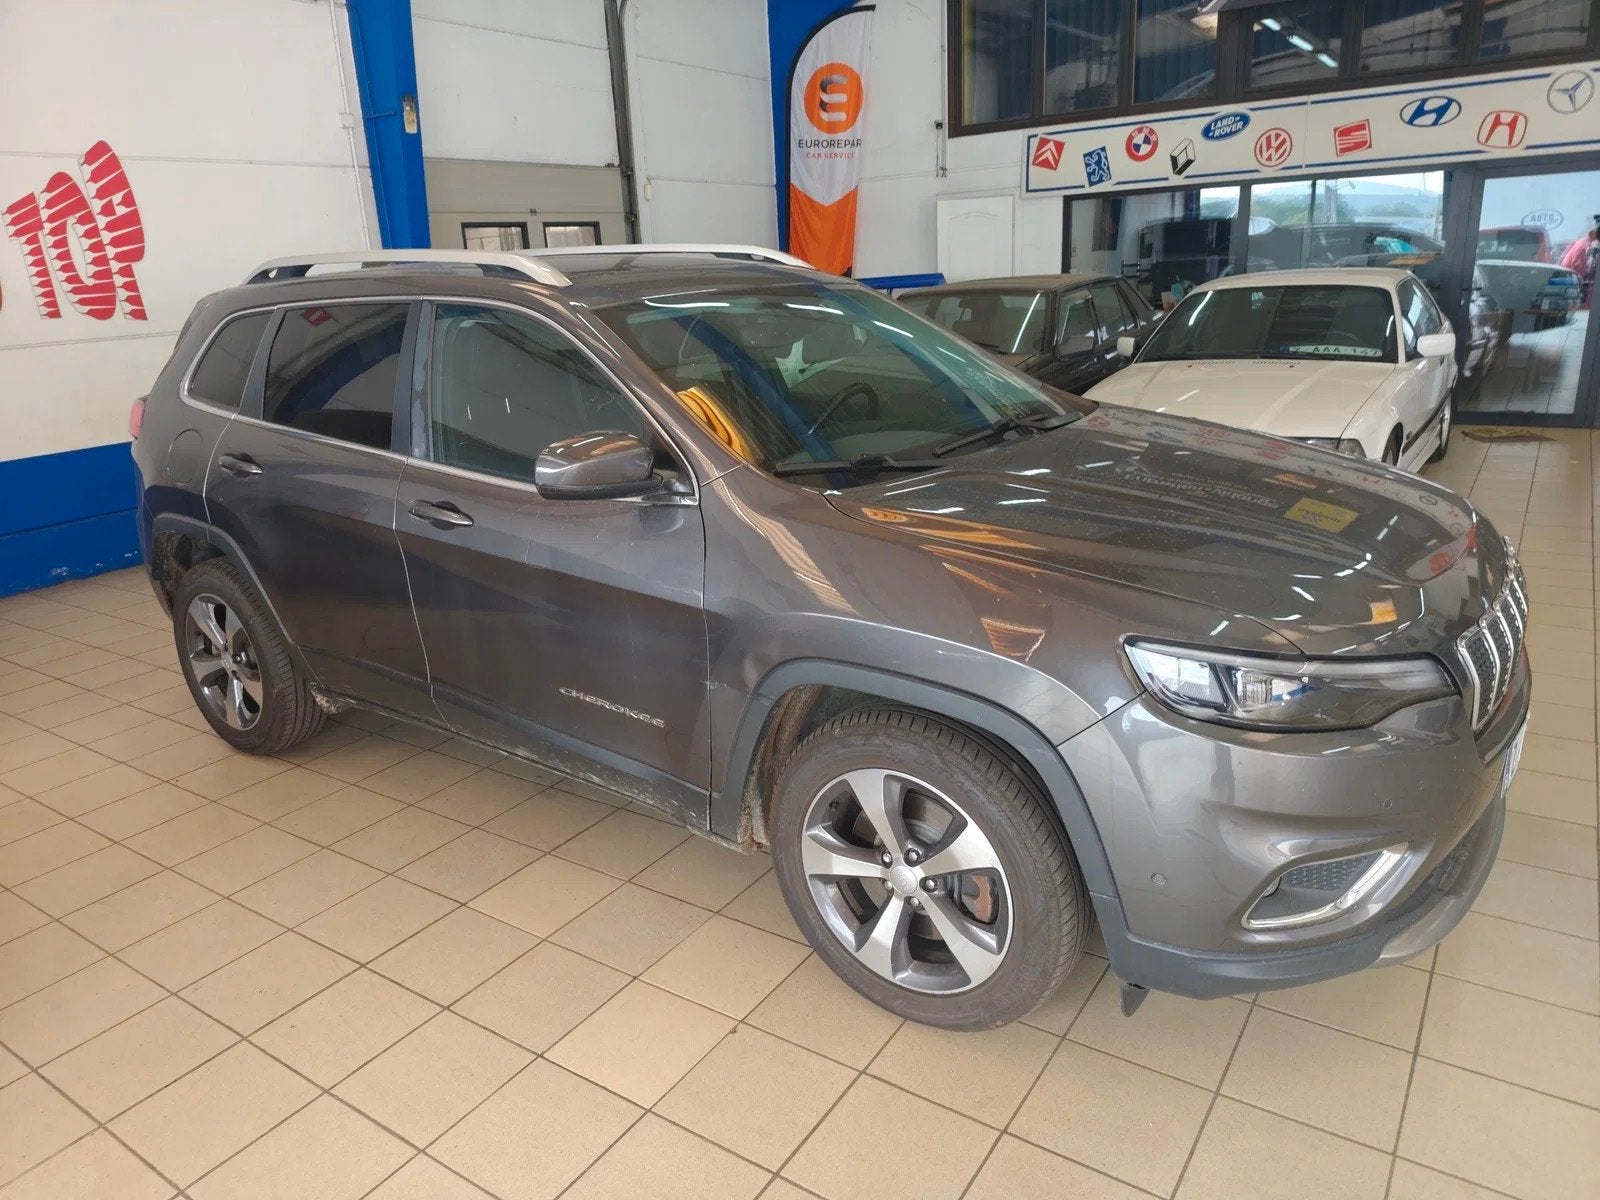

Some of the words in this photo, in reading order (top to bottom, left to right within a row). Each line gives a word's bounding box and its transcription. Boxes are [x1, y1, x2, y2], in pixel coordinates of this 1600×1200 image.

[798, 138, 863, 149] EUROREPAR
[824, 152, 855, 160] SERVICE
[559, 687, 665, 728] CHEROKEE
